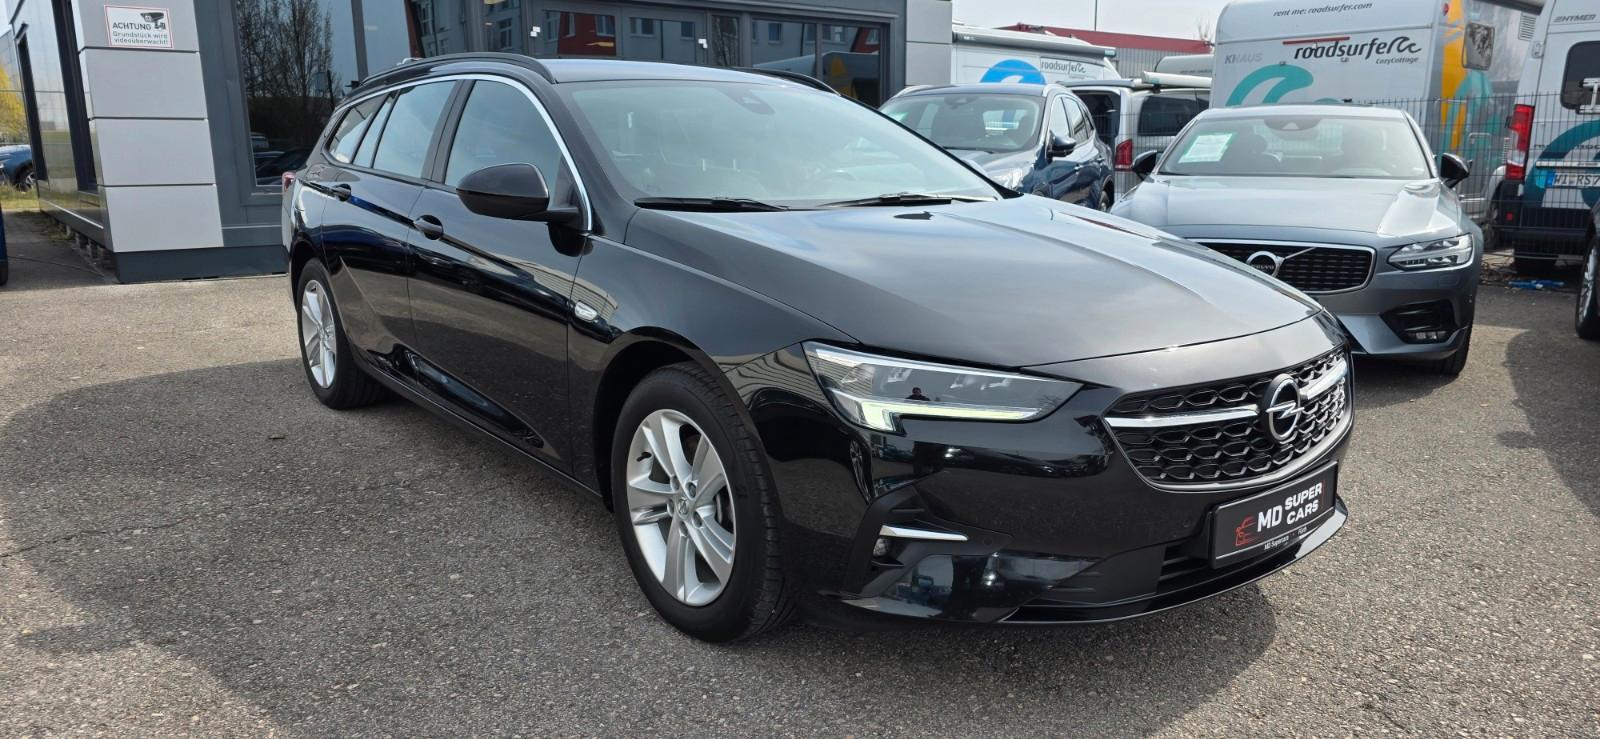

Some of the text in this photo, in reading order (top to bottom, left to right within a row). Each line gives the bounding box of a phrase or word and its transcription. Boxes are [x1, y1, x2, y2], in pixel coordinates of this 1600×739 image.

[1273, 9, 1291, 17] rent
[1307, 3, 1373, 14] roadsurfer.com
[112, 22, 151, 30] ACHTUNG
[1294, 36, 1421, 60] roadsurfer
[1224, 53, 1262, 64] KNAUS
[1375, 57, 1419, 65] CozyCottage
[1041, 61, 1086, 74] roadsurfer
[1554, 174, 1569, 185] WI
[1257, 482, 1322, 532] MD SUPER
[1286, 499, 1319, 525] CARS
